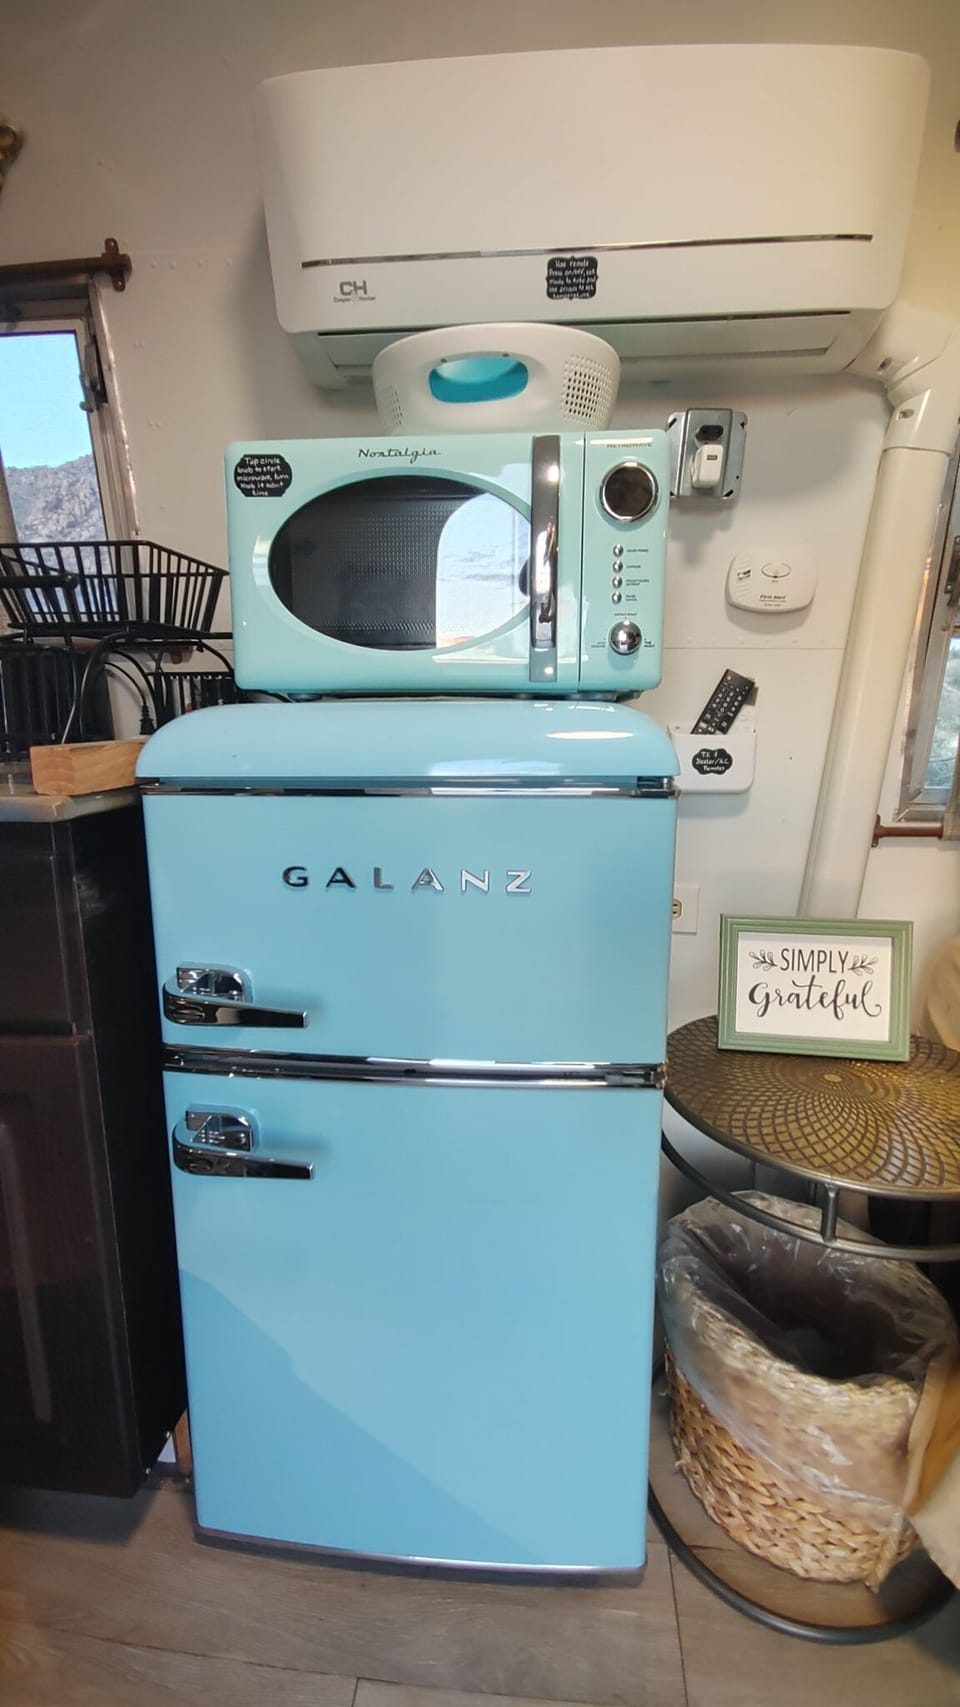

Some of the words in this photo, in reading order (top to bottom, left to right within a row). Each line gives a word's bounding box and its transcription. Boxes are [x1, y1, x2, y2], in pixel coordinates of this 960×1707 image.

[569, 259, 589, 267] remote
[339, 280, 368, 296] CH
[244, 457, 259, 466] Tap
[358, 447, 442, 465] Nostalgia
[273, 472, 289, 480] turn
[281, 865, 533, 894] GALANZ
[780, 947, 849, 975] SIMPLY
[748, 974, 882, 1021] Grateful
